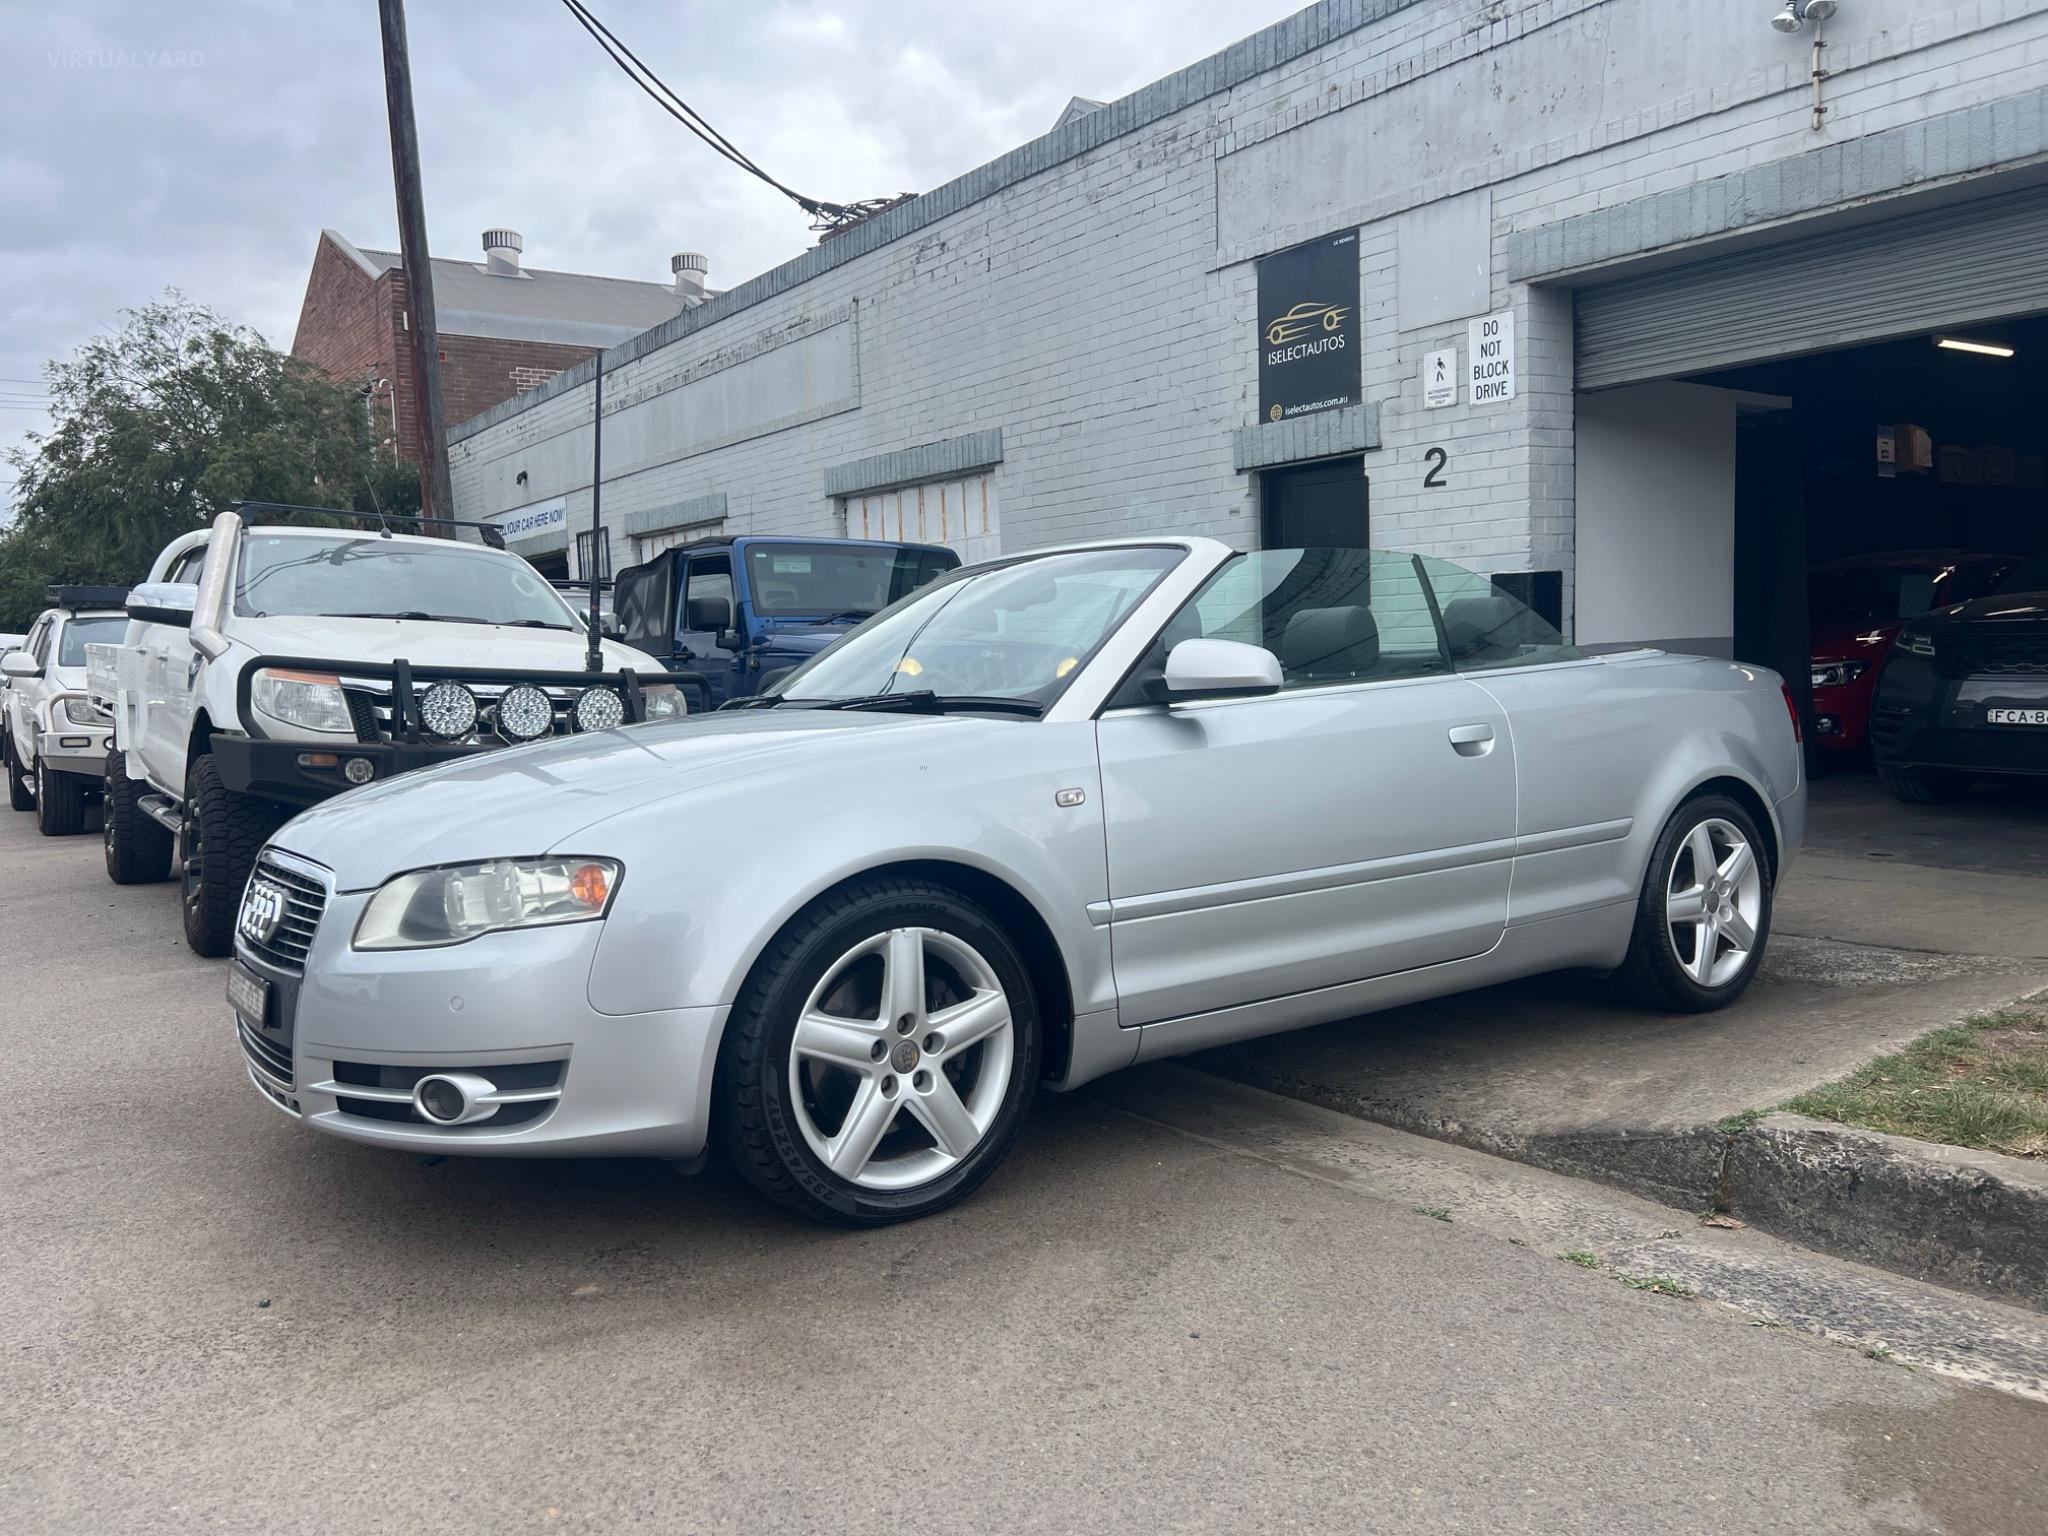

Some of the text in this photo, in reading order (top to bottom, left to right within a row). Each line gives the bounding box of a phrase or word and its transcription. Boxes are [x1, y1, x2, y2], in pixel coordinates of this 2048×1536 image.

[1483, 320, 1498, 337] DO
[1268, 334, 1345, 366] ISELECTAUTOS
[1480, 340, 1502, 359] NOT
[1473, 360, 1509, 381] BLOCK
[1476, 381, 1508, 400] DRIVE
[1285, 396, 1348, 416] iselectautos.com.au
[1423, 447, 1447, 488] 2
[507, 520, 521, 535] YOUR
[521, 516, 534, 532] CAR
[534, 512, 549, 527] HERE
